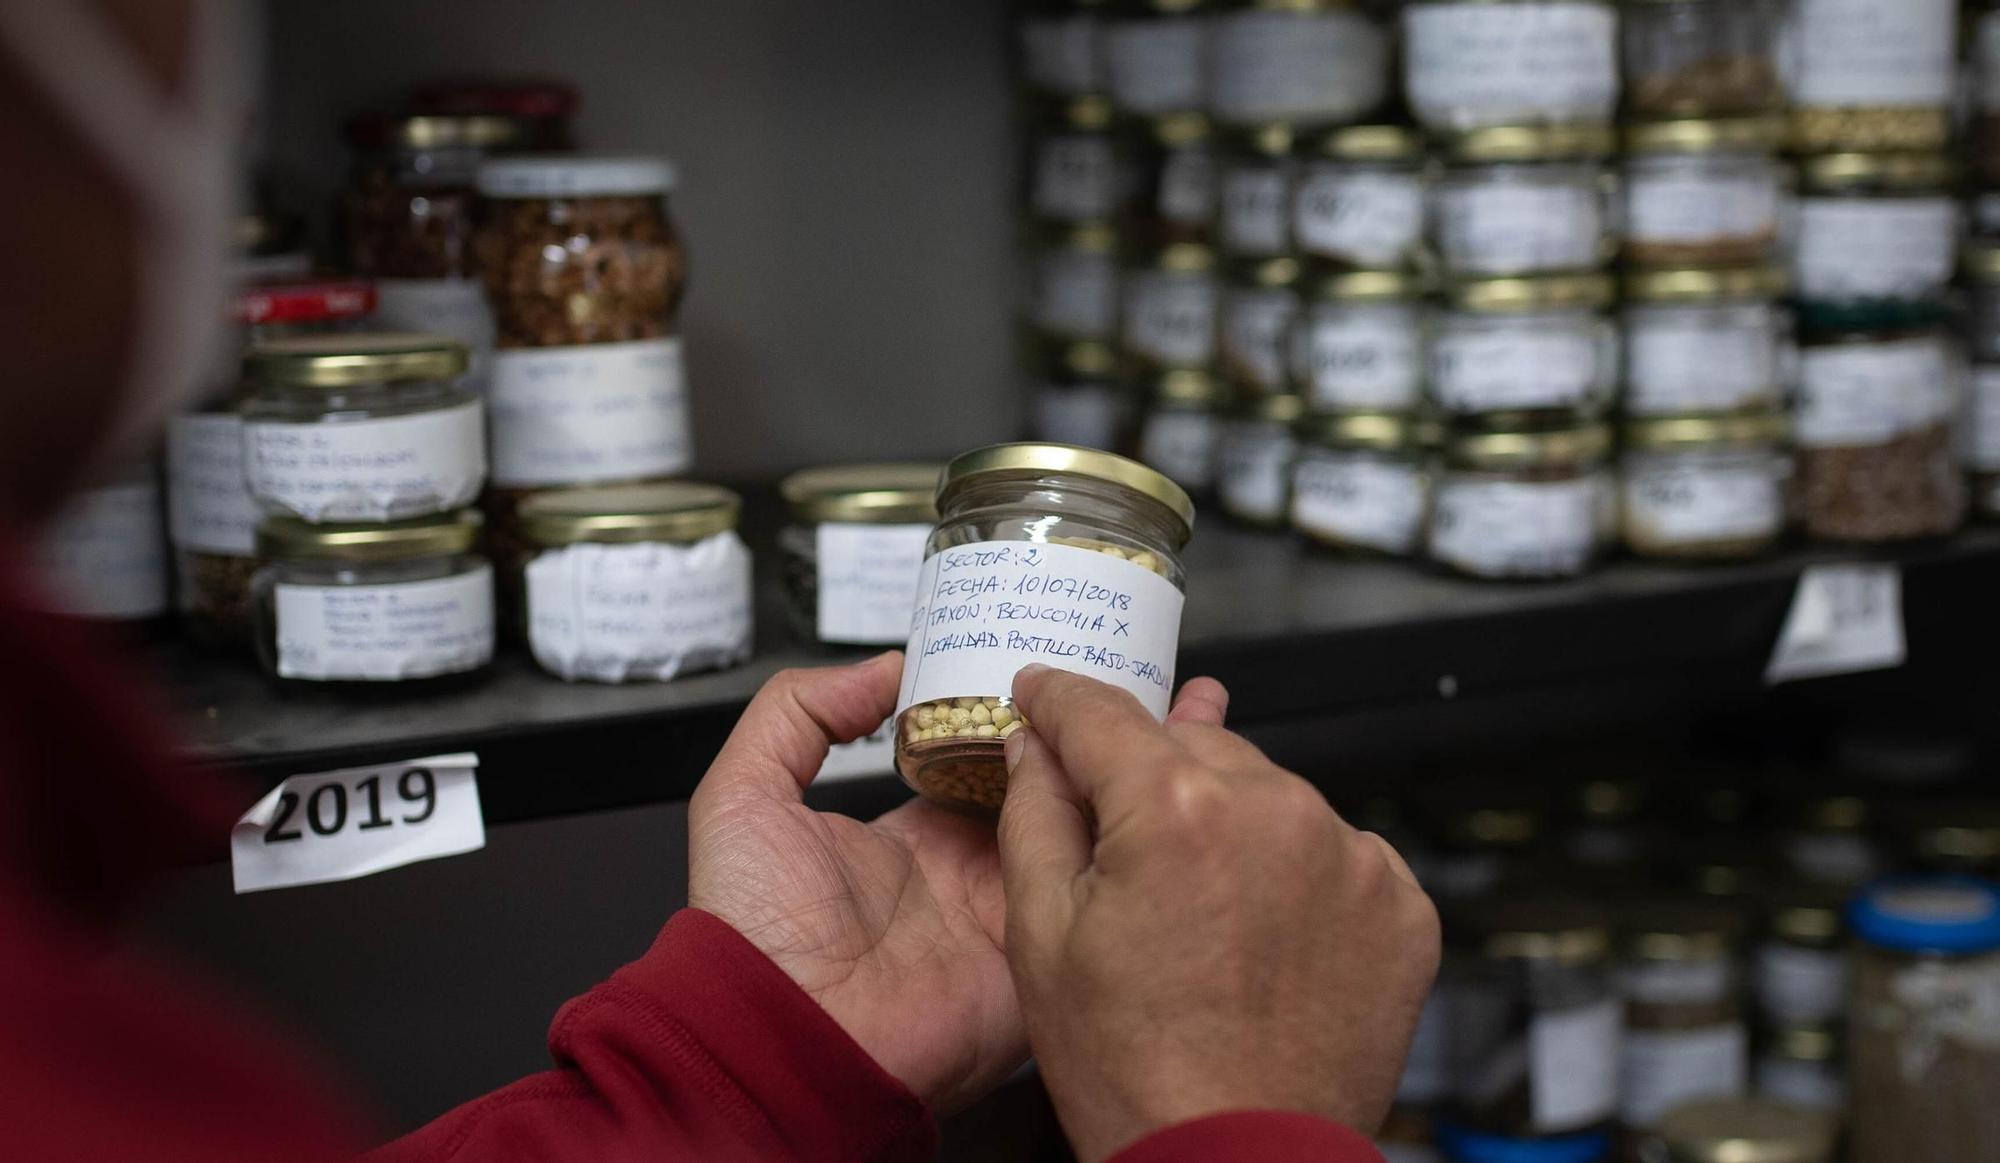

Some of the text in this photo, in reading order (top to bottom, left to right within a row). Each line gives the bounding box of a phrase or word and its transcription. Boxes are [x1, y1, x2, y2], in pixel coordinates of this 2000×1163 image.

[942, 547, 1043, 572] SECTOR: 2
[937, 575, 1007, 598] FECHA:
[1013, 573, 1132, 611] 10/07/2018
[997, 602, 1104, 632] BENCOMIA
[1112, 618, 1130, 637] X
[1007, 630, 1081, 656] PORTILLO
[263, 766, 437, 844] 2019
